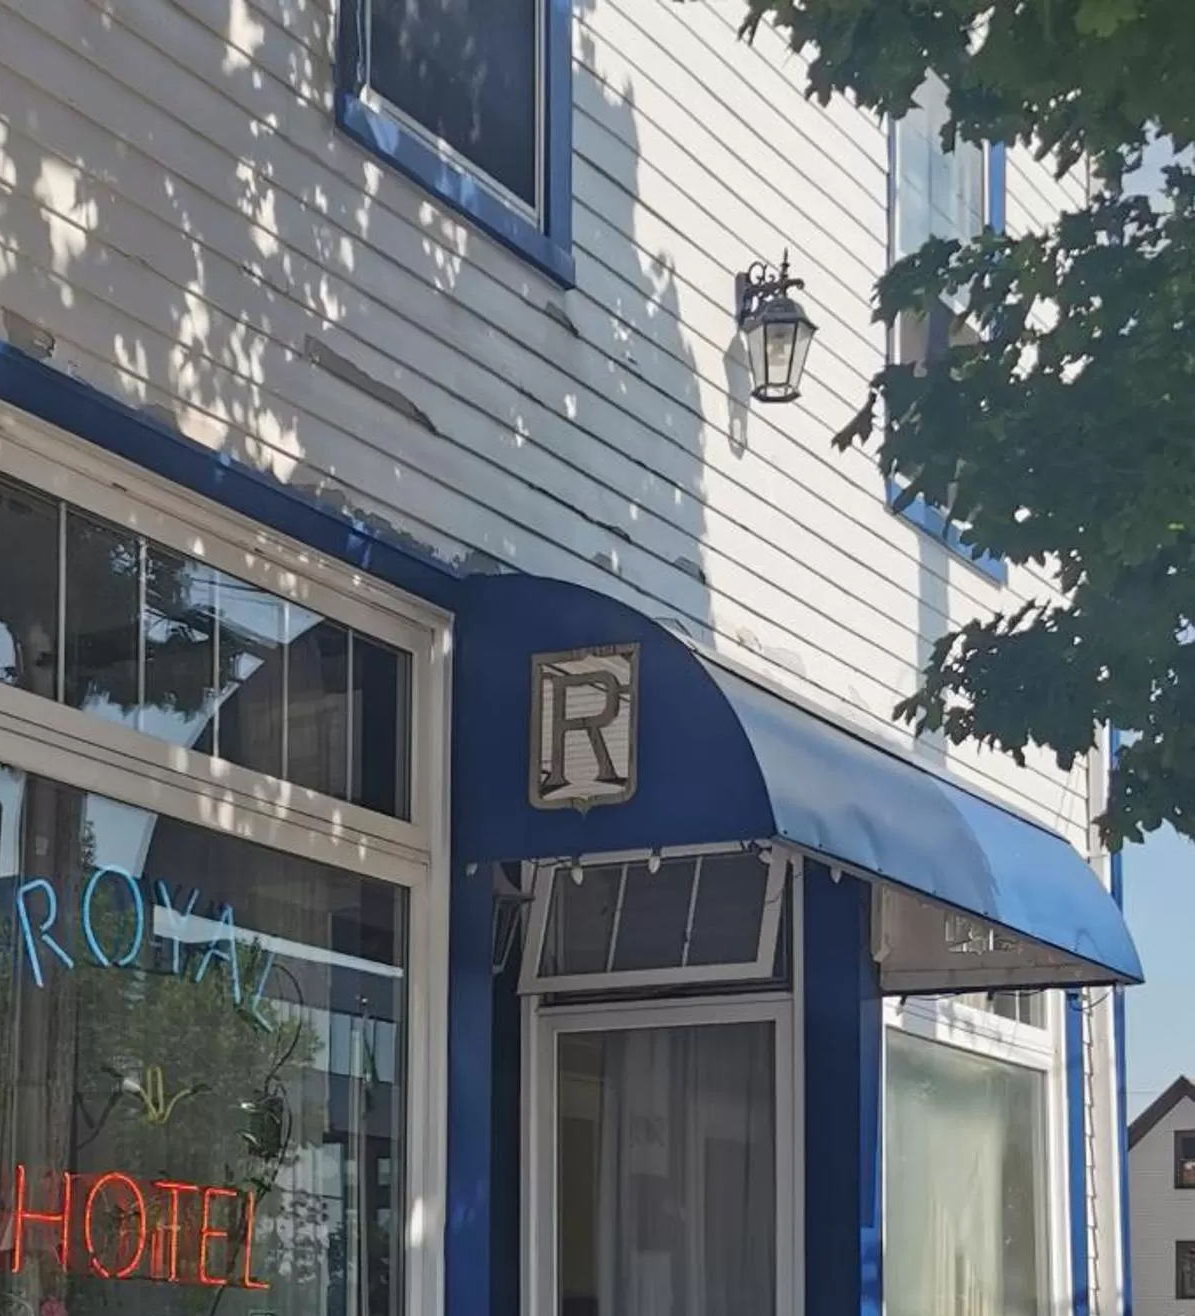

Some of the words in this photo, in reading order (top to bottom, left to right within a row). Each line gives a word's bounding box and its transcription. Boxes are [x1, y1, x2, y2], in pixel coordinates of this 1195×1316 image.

[539, 669, 629, 793] R
[16, 865, 276, 1034] ROYAL
[11, 1164, 271, 1289] HOTEL
